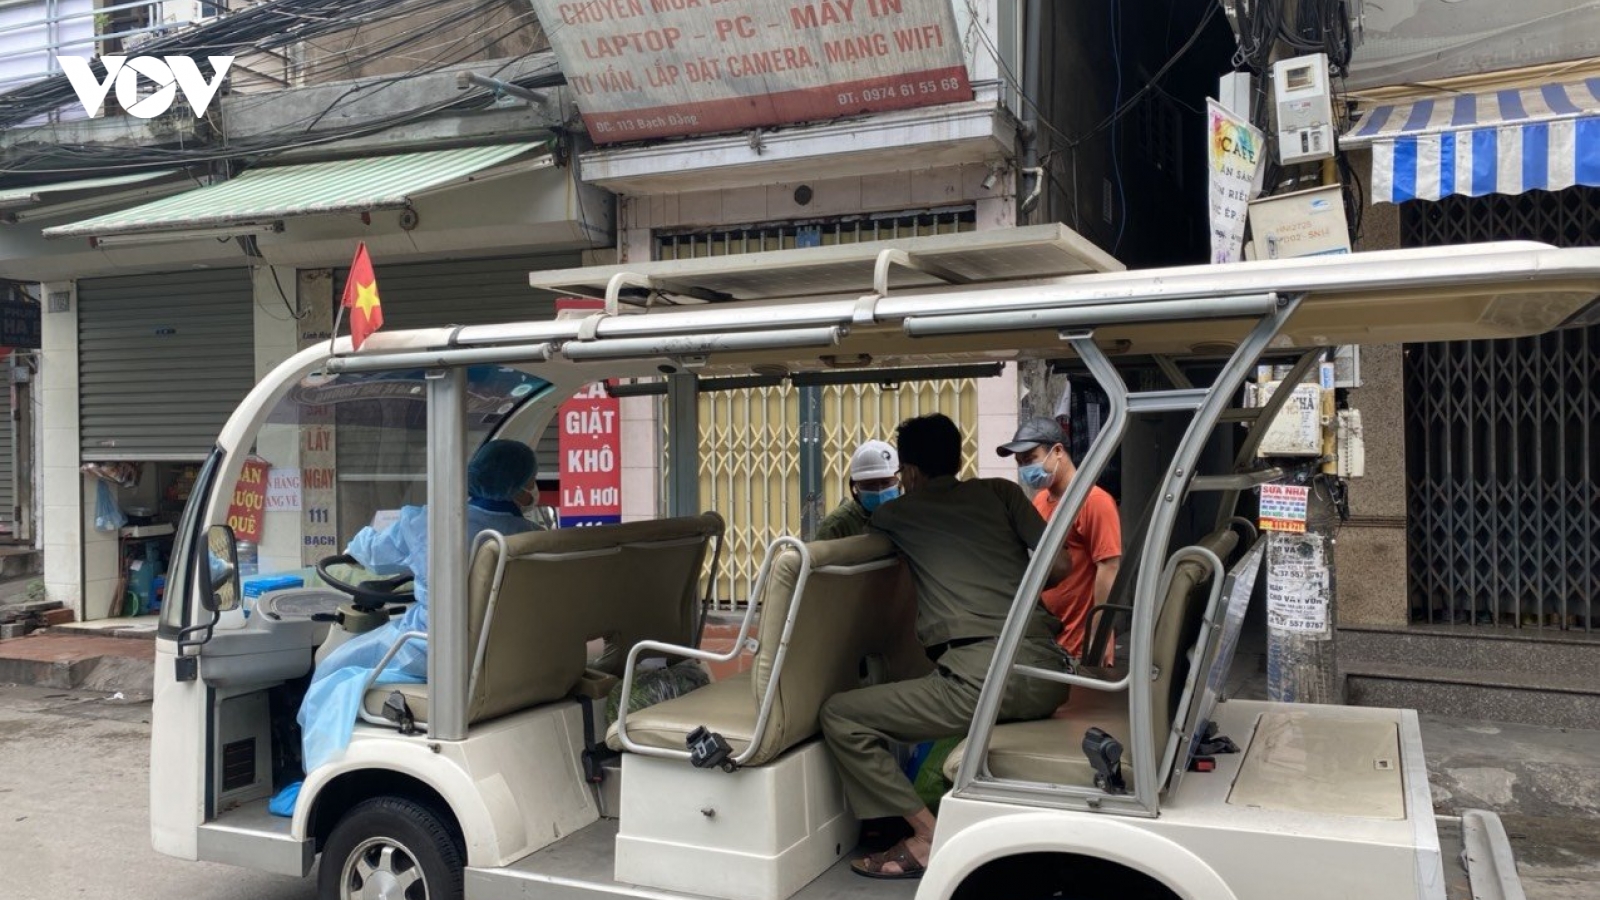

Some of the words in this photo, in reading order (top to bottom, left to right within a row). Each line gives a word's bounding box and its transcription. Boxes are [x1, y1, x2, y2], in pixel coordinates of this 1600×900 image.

[581, 27, 682, 59] LAPTOP
[715, 15, 756, 42] PC
[866, 0, 902, 18] IN
[568, 72, 594, 96] TƯ
[645, 58, 680, 88] LẮP
[685, 56, 721, 86] ĐẶT
[726, 46, 819, 77] CAMERA,
[823, 33, 888, 64] MẠNG
[893, 24, 943, 53] WIFI
[863, 86, 895, 102] 0974
[901, 84, 915, 97] 61
[920, 81, 937, 93] 55
[941, 77, 959, 91] 68
[617, 120, 635, 131] 113
[566, 406, 615, 439] GIẶT
[567, 444, 614, 473] KHÔ
[304, 468, 334, 489] NGAY
[564, 486, 585, 507] LÀ
[591, 487, 618, 506] HƠI
[228, 515, 257, 535] QUÊ
[309, 508, 328, 523] 111
[304, 535, 335, 548] BẠCH
